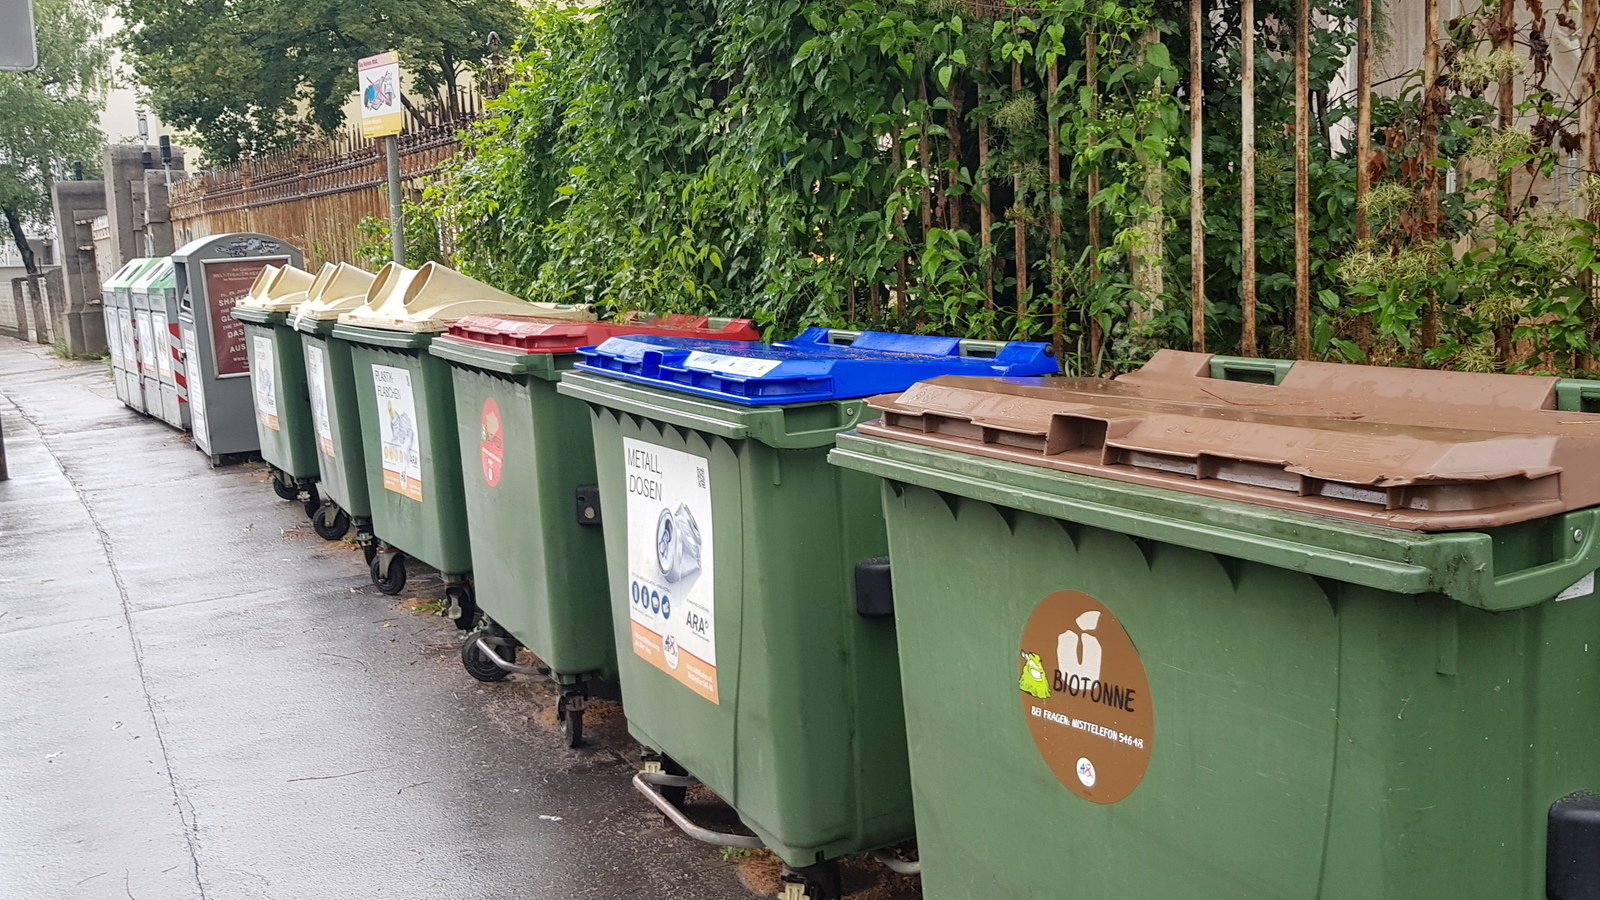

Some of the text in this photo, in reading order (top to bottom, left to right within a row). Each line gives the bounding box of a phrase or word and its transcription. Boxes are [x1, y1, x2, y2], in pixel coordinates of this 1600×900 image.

[221, 314, 237, 323] GL
[227, 329, 245, 339] DAS
[627, 447, 663, 479] METALL,
[629, 474, 662, 502] DOSEN
[1053, 669, 1136, 712] BIOTONNE
[1031, 706, 1042, 717] BEI
[1043, 709, 1071, 726] FRAGEN:
[1071, 718, 1118, 741] MISTTELEFON
